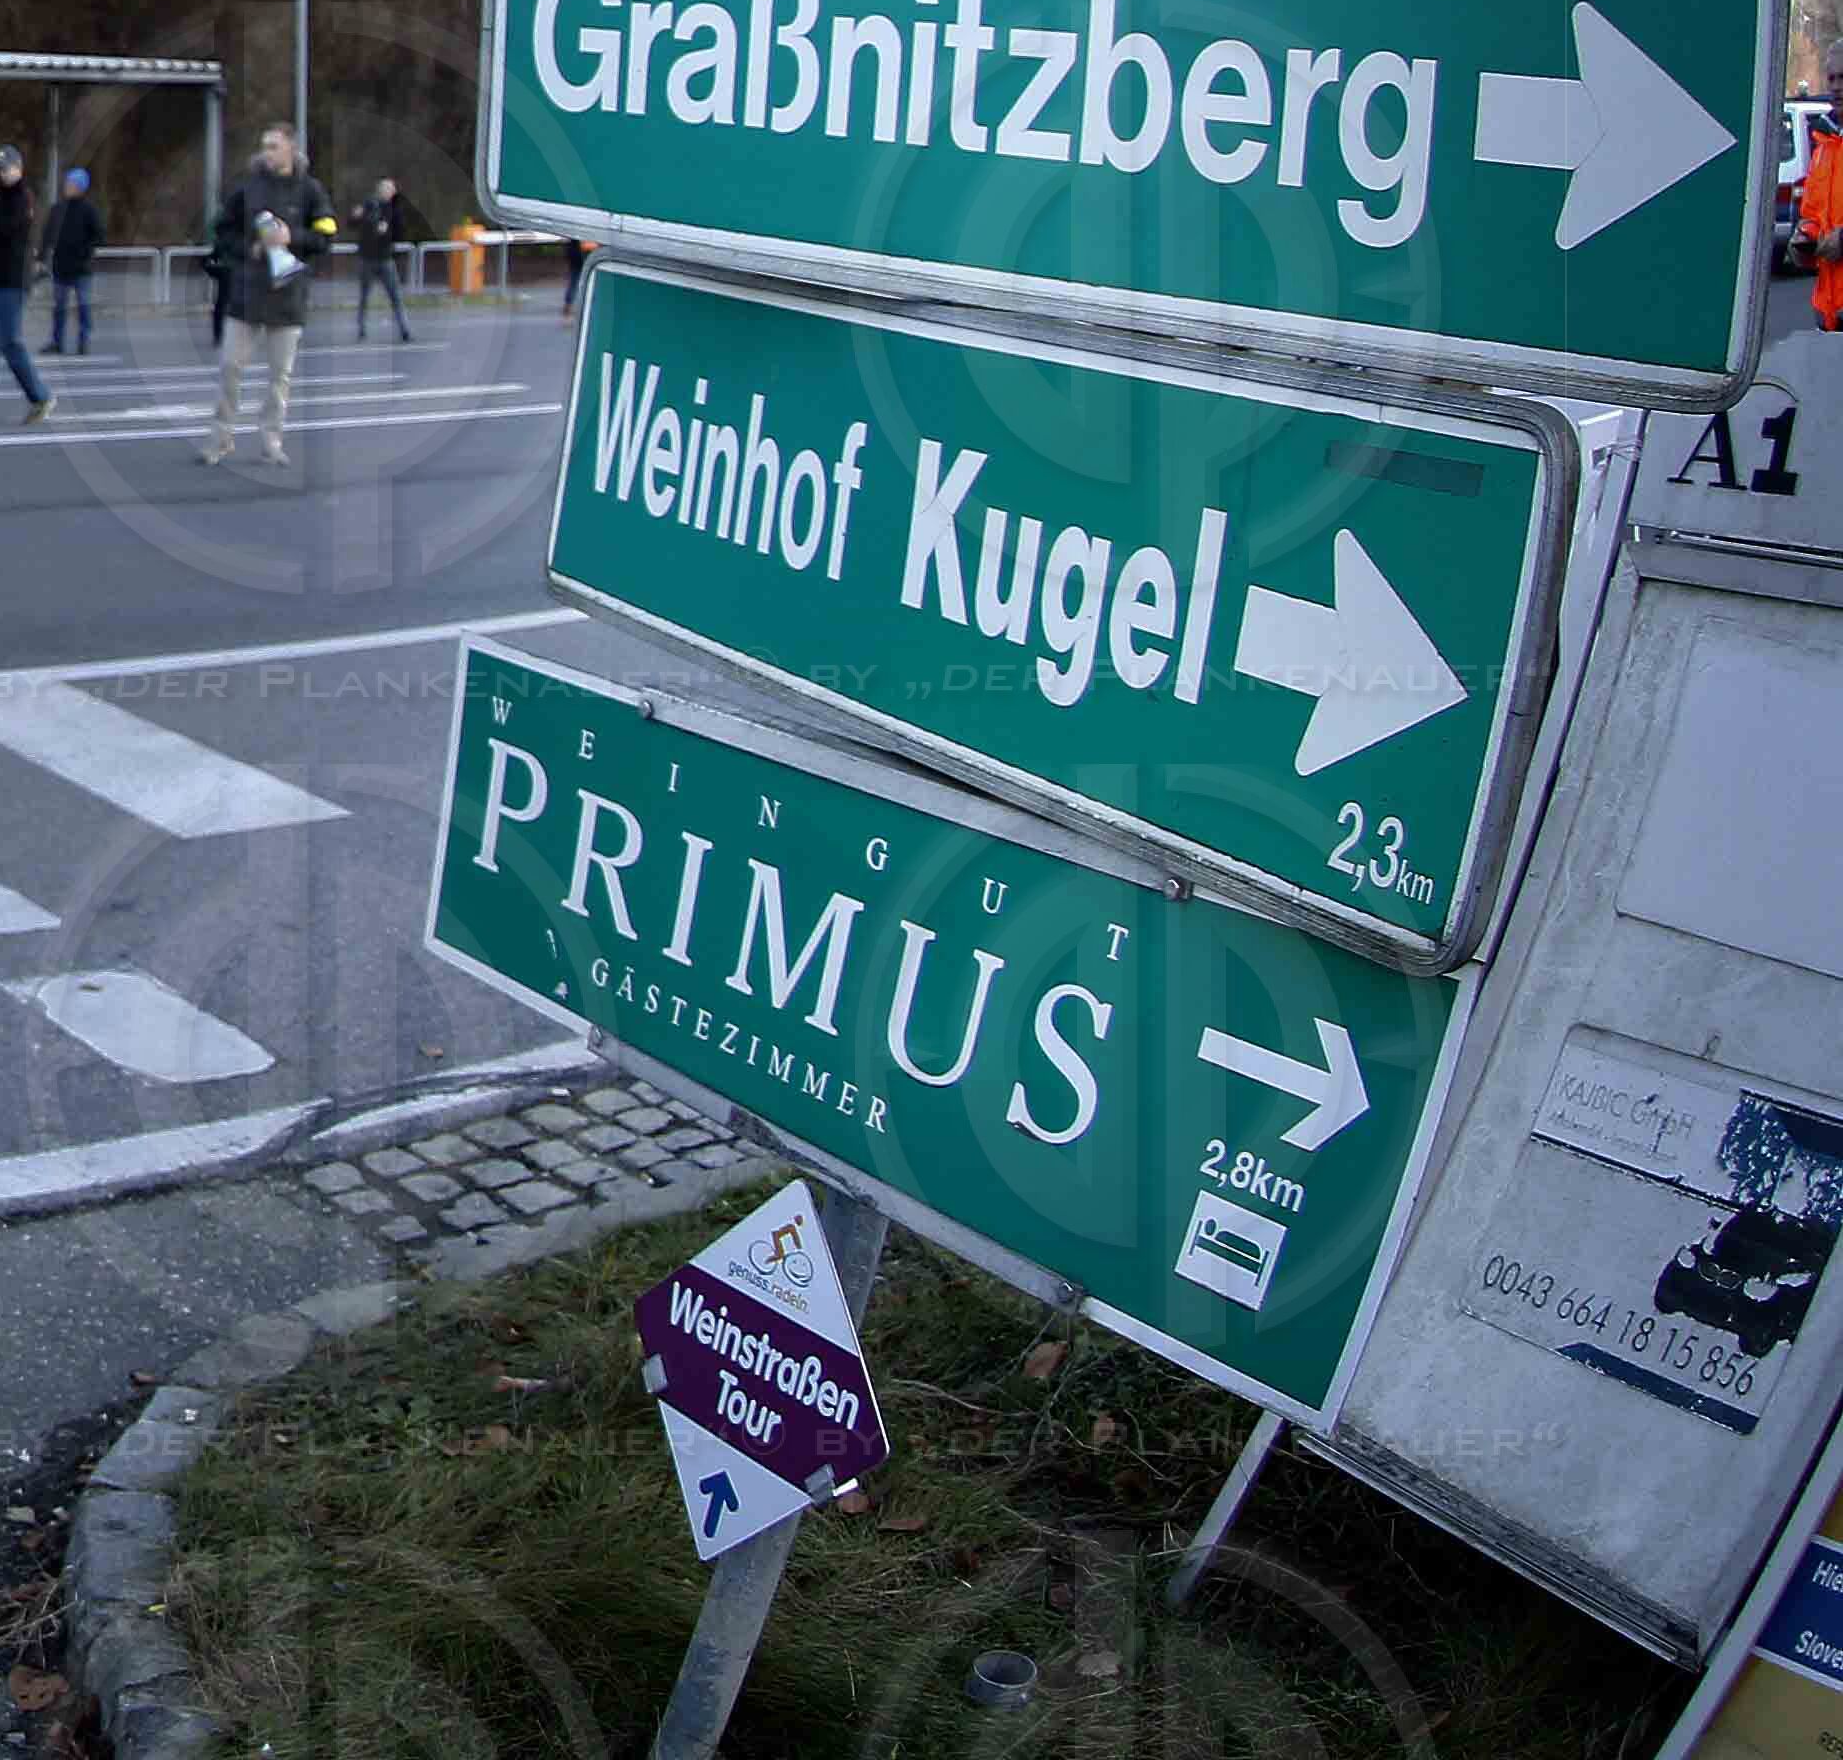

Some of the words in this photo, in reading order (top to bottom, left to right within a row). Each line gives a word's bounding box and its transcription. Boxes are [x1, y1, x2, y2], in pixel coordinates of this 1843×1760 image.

[594, 352, 867, 581] Weinhof
[899, 438, 1228, 707] Kugel
[1667, 407, 1798, 496] A1
[492, 695, 1129, 962] WEINGUT
[472, 737, 1113, 1145] PRIMUS
[591, 958, 888, 1133] GÄSTEZIMMER
[669, 1281, 860, 1430] Weinstraßen
[718, 1370, 782, 1443] Tour
[1482, 1254, 1553, 1309] 0043
[1555, 1286, 1613, 1334] 664
[1617, 1309, 1655, 1353] 18
[1659, 1328, 1694, 1370] 15
[1699, 1345, 1757, 1397] 856
